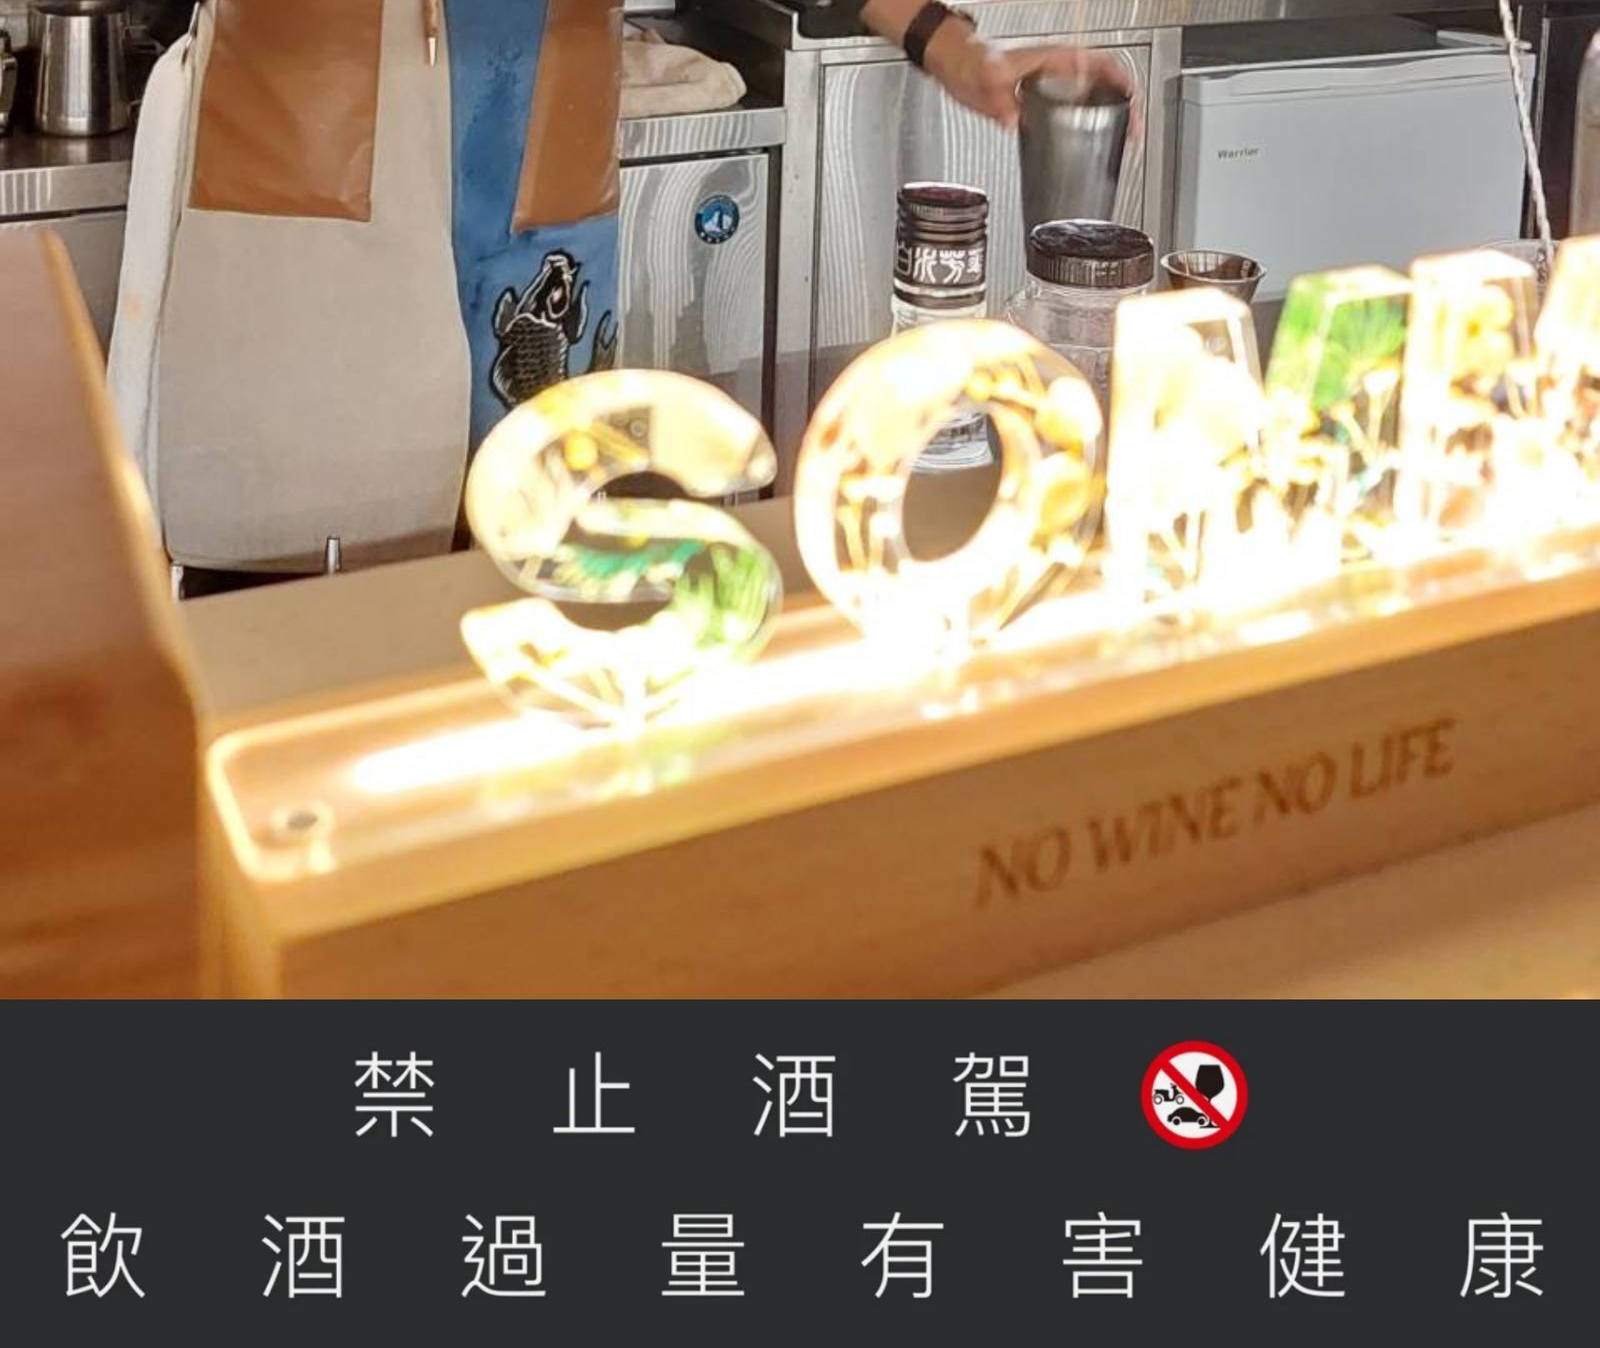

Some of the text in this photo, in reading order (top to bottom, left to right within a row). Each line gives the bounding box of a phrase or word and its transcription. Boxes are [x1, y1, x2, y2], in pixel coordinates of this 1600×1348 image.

[975, 717, 1457, 908] NO WINE NO LIFE
